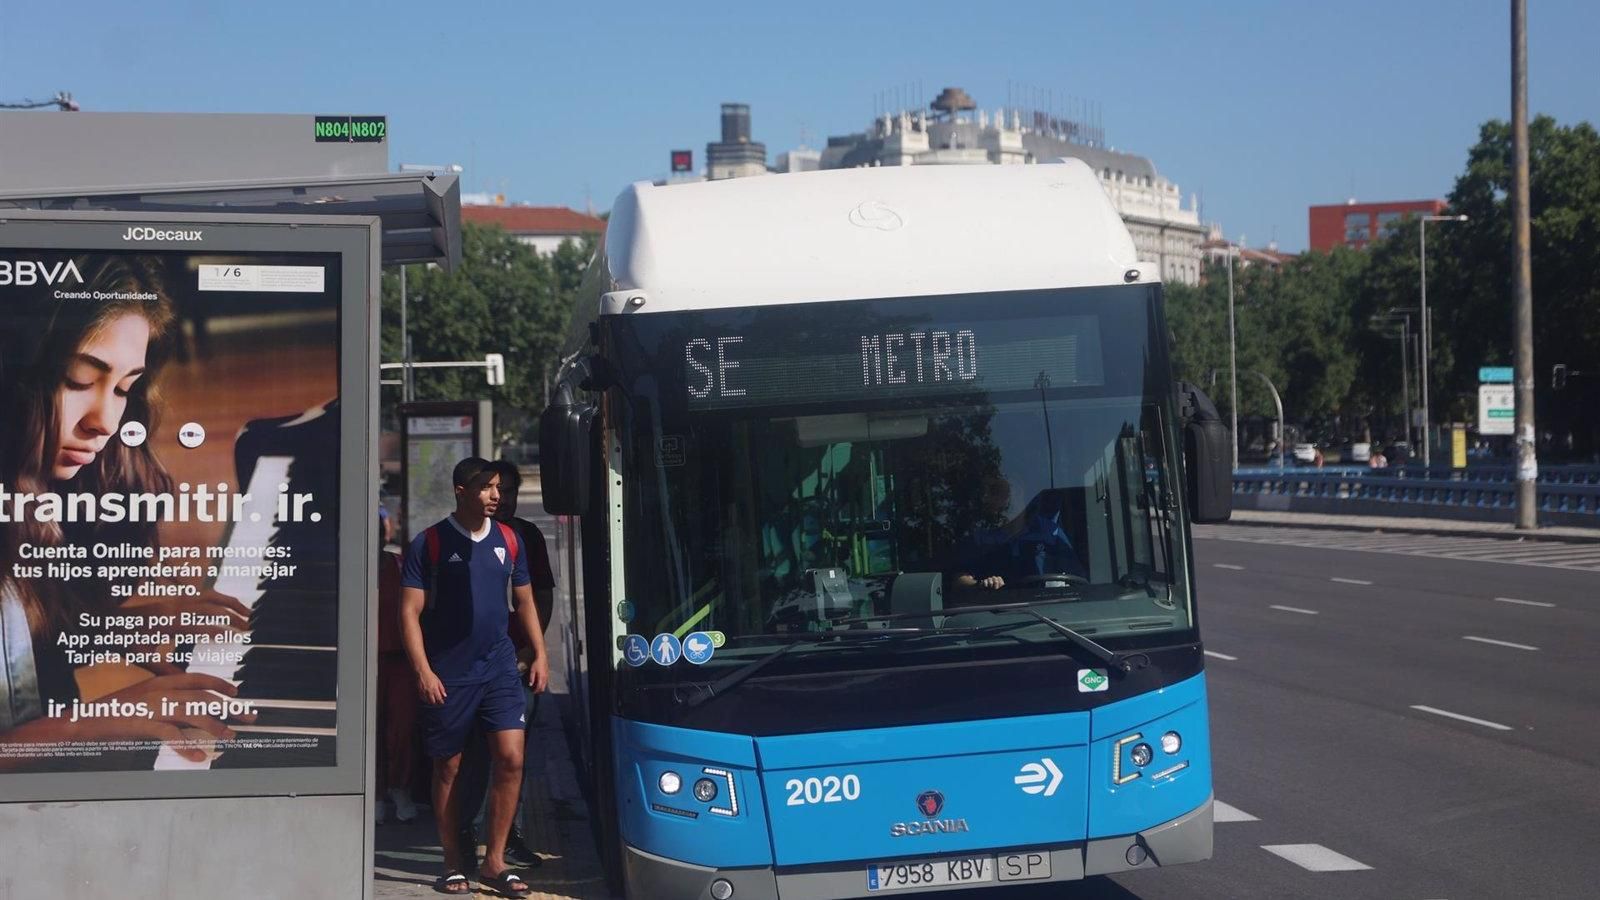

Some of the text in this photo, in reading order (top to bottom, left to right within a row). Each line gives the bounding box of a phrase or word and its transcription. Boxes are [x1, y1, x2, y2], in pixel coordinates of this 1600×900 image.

[315, 121, 349, 137] N804
[352, 121, 385, 137] N802
[122, 227, 203, 241] JCDecaux
[53, 290, 158, 301] Creando Oportunidades
[685, 330, 977, 398] SE METRO
[277, 482, 322, 523] ir.
[18, 543, 292, 562] Cuenta Online para menores:
[12, 561, 297, 582] tus hijos aprenderán a manejar
[110, 581, 201, 597] su dinero.
[79, 612, 231, 630] Su paga por Bizum
[56, 630, 252, 646] App adaptada para ellos
[713, 633, 721, 643] 3
[65, 649, 243, 666] Tarjeta para sus viajes
[1084, 676, 1101, 684] GNC
[47, 697, 259, 722] ir juntos, ir mejor.
[785, 774, 861, 806] 2020
[891, 818, 970, 837] SCANIA
[882, 862, 934, 887] 7958
[947, 858, 985, 882] KBV
[1006, 854, 1042, 876] SP
